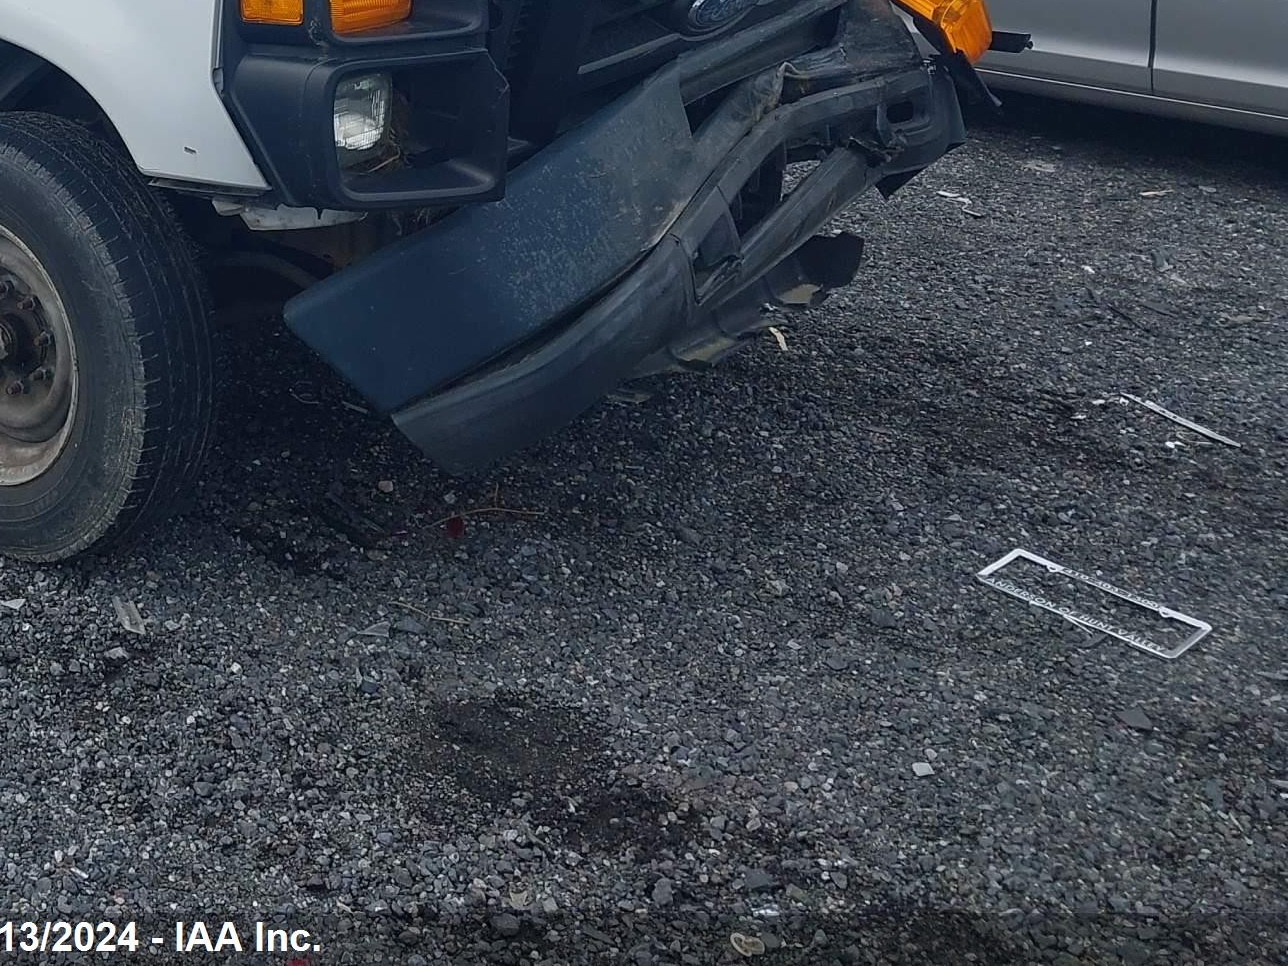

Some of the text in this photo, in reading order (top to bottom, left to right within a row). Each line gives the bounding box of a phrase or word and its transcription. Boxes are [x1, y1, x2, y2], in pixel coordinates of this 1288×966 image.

[985, 577, 1165, 652] ANDERSON OF HUNT VALLEY
